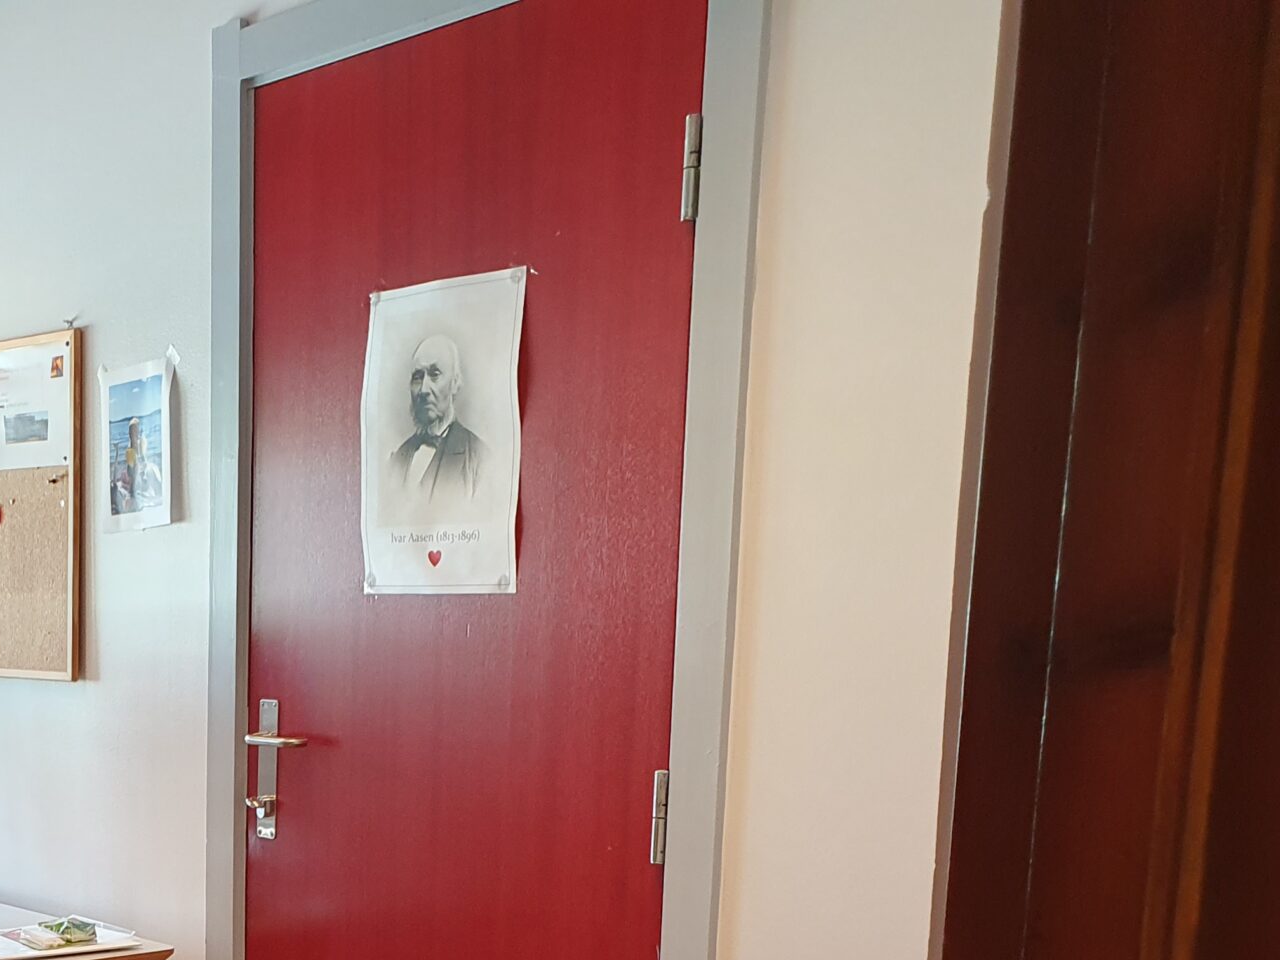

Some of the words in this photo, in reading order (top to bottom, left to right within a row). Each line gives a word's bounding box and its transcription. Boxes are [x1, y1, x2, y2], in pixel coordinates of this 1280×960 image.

[391, 532, 406, 544] Ivar
[408, 532, 434, 544] Aasen
[436, 529, 480, 545] (1813-1896)
